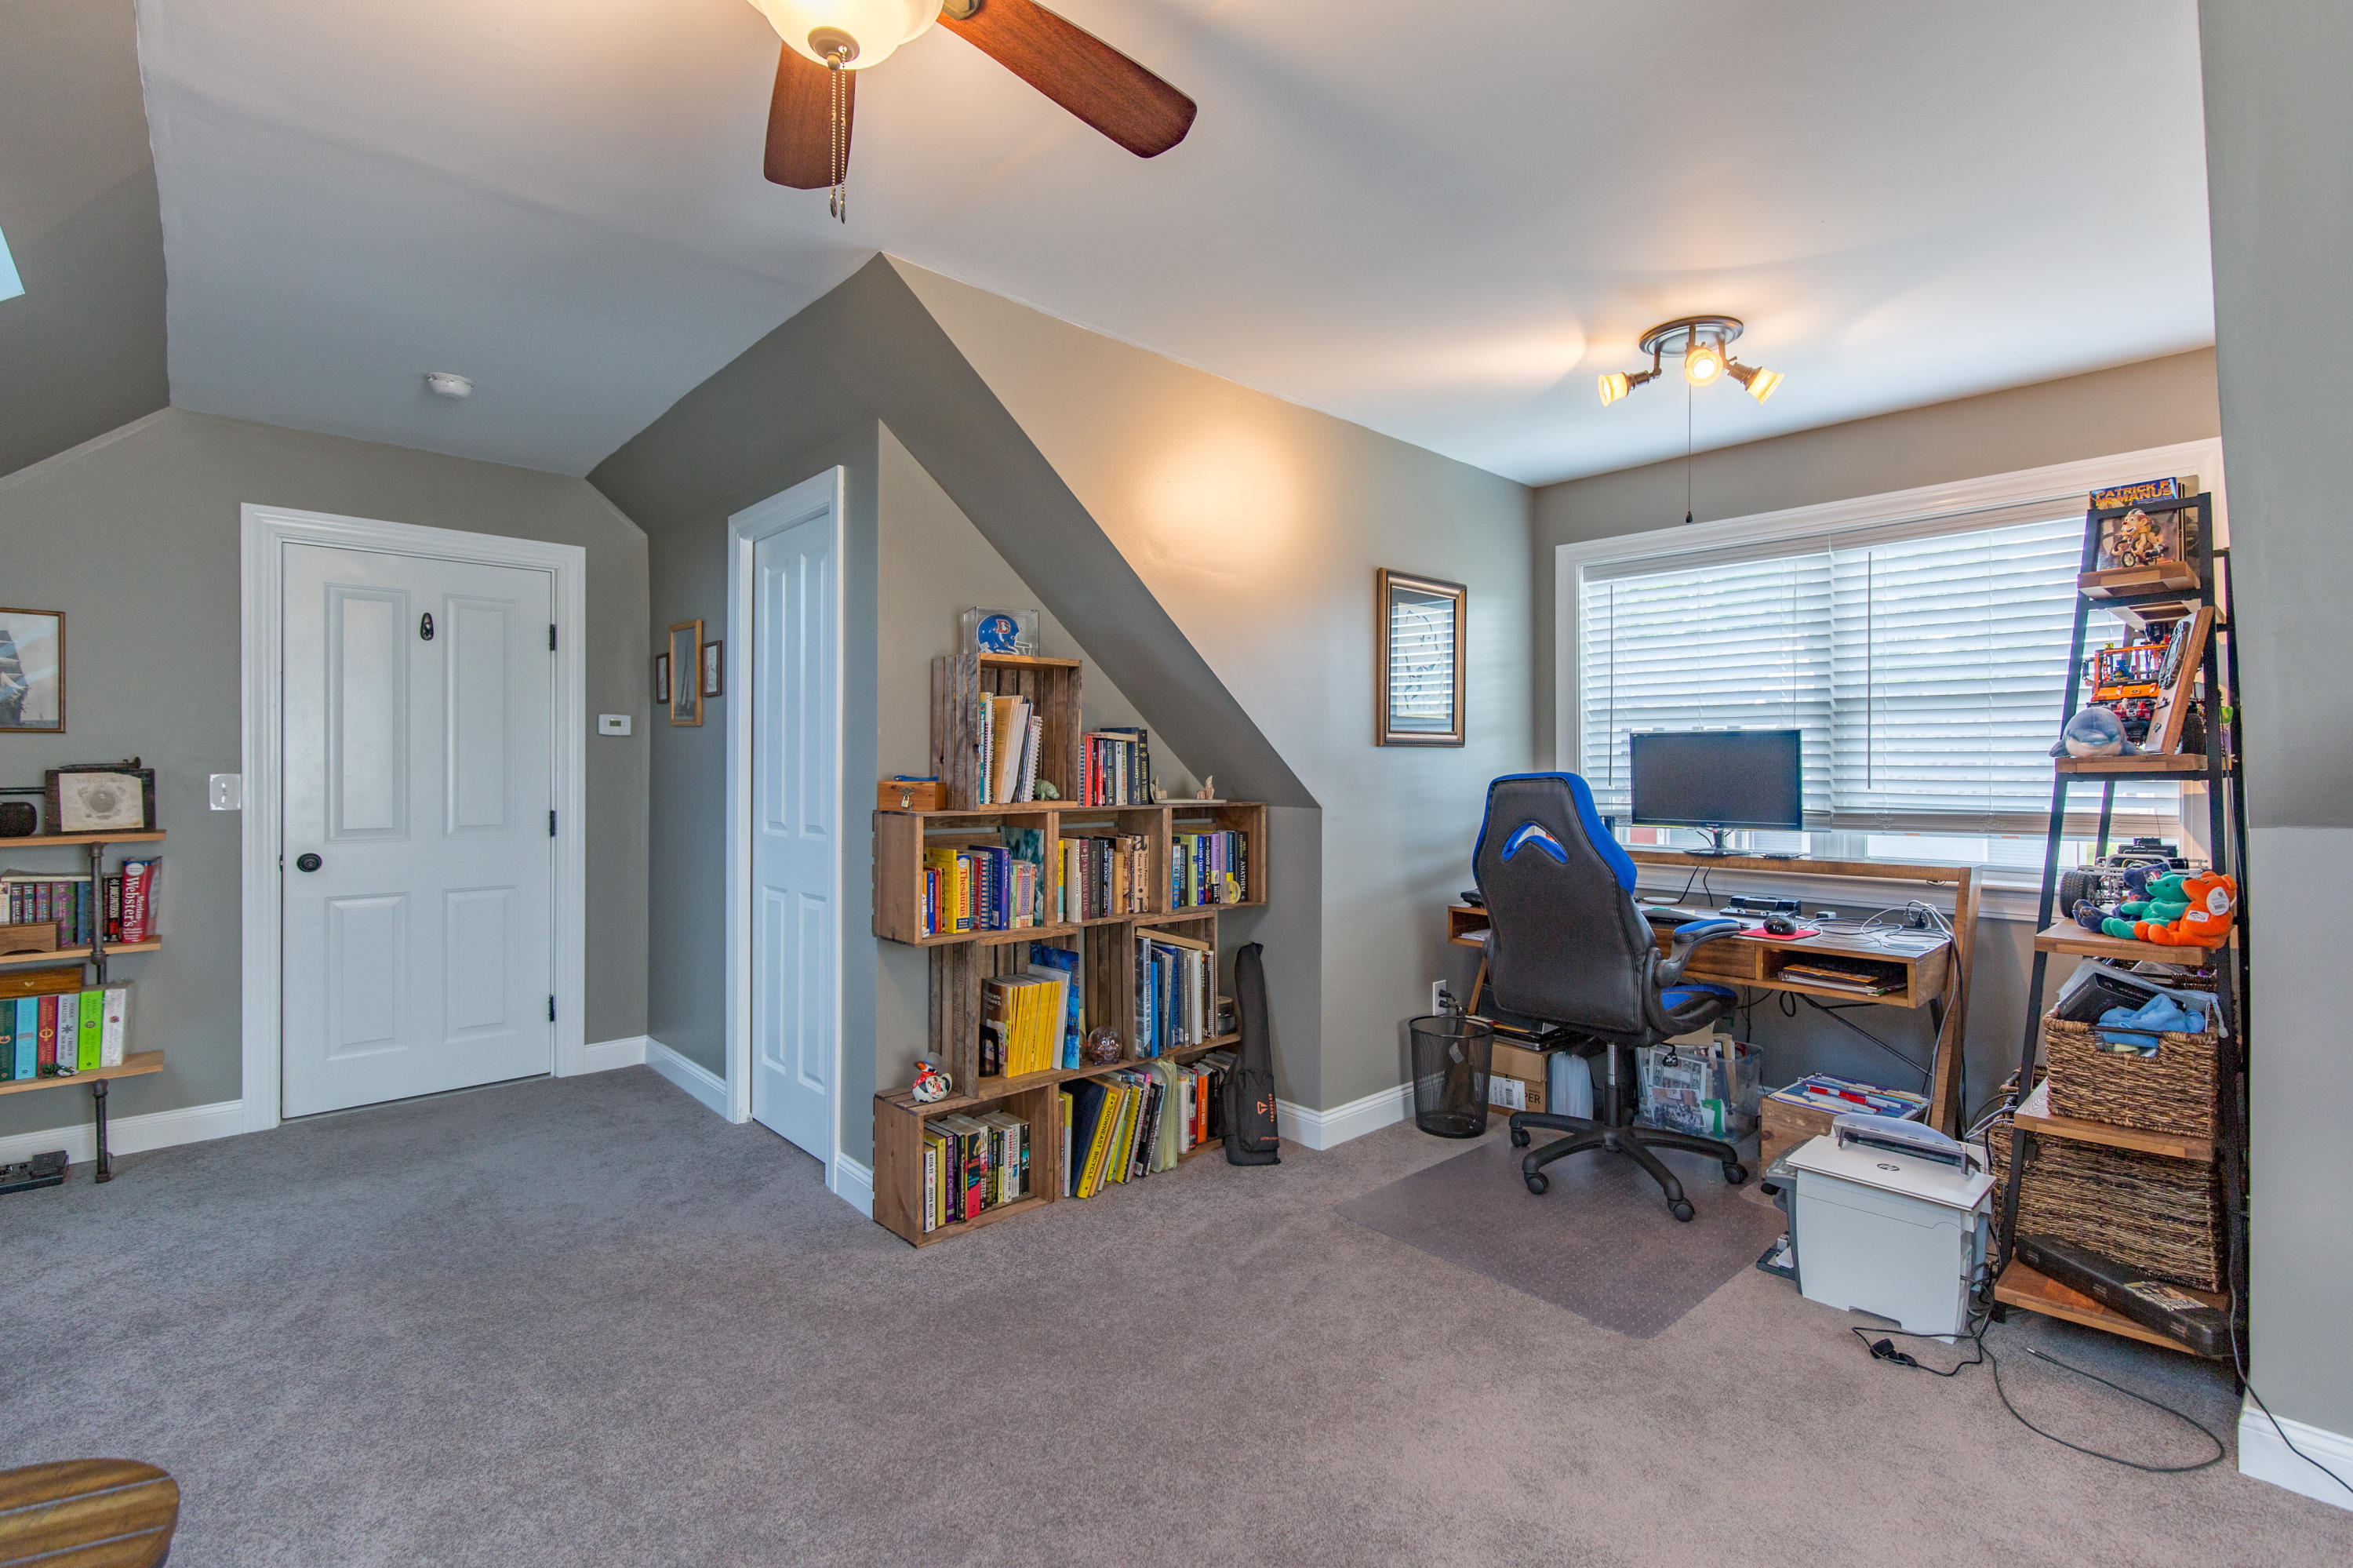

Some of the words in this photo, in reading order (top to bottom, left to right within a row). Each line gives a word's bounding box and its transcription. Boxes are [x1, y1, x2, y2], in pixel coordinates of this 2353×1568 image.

[2096, 483, 2156, 500] PATRICK
[109, 897, 119, 919] PATTERSON
[123, 876, 140, 928] Webster's
[959, 869, 968, 917] Thesaurus
[136, 896, 145, 921] Merriam-
[1096, 1110, 1111, 1148] DOWNEAST
[1086, 1151, 1100, 1181] BICYCLE
